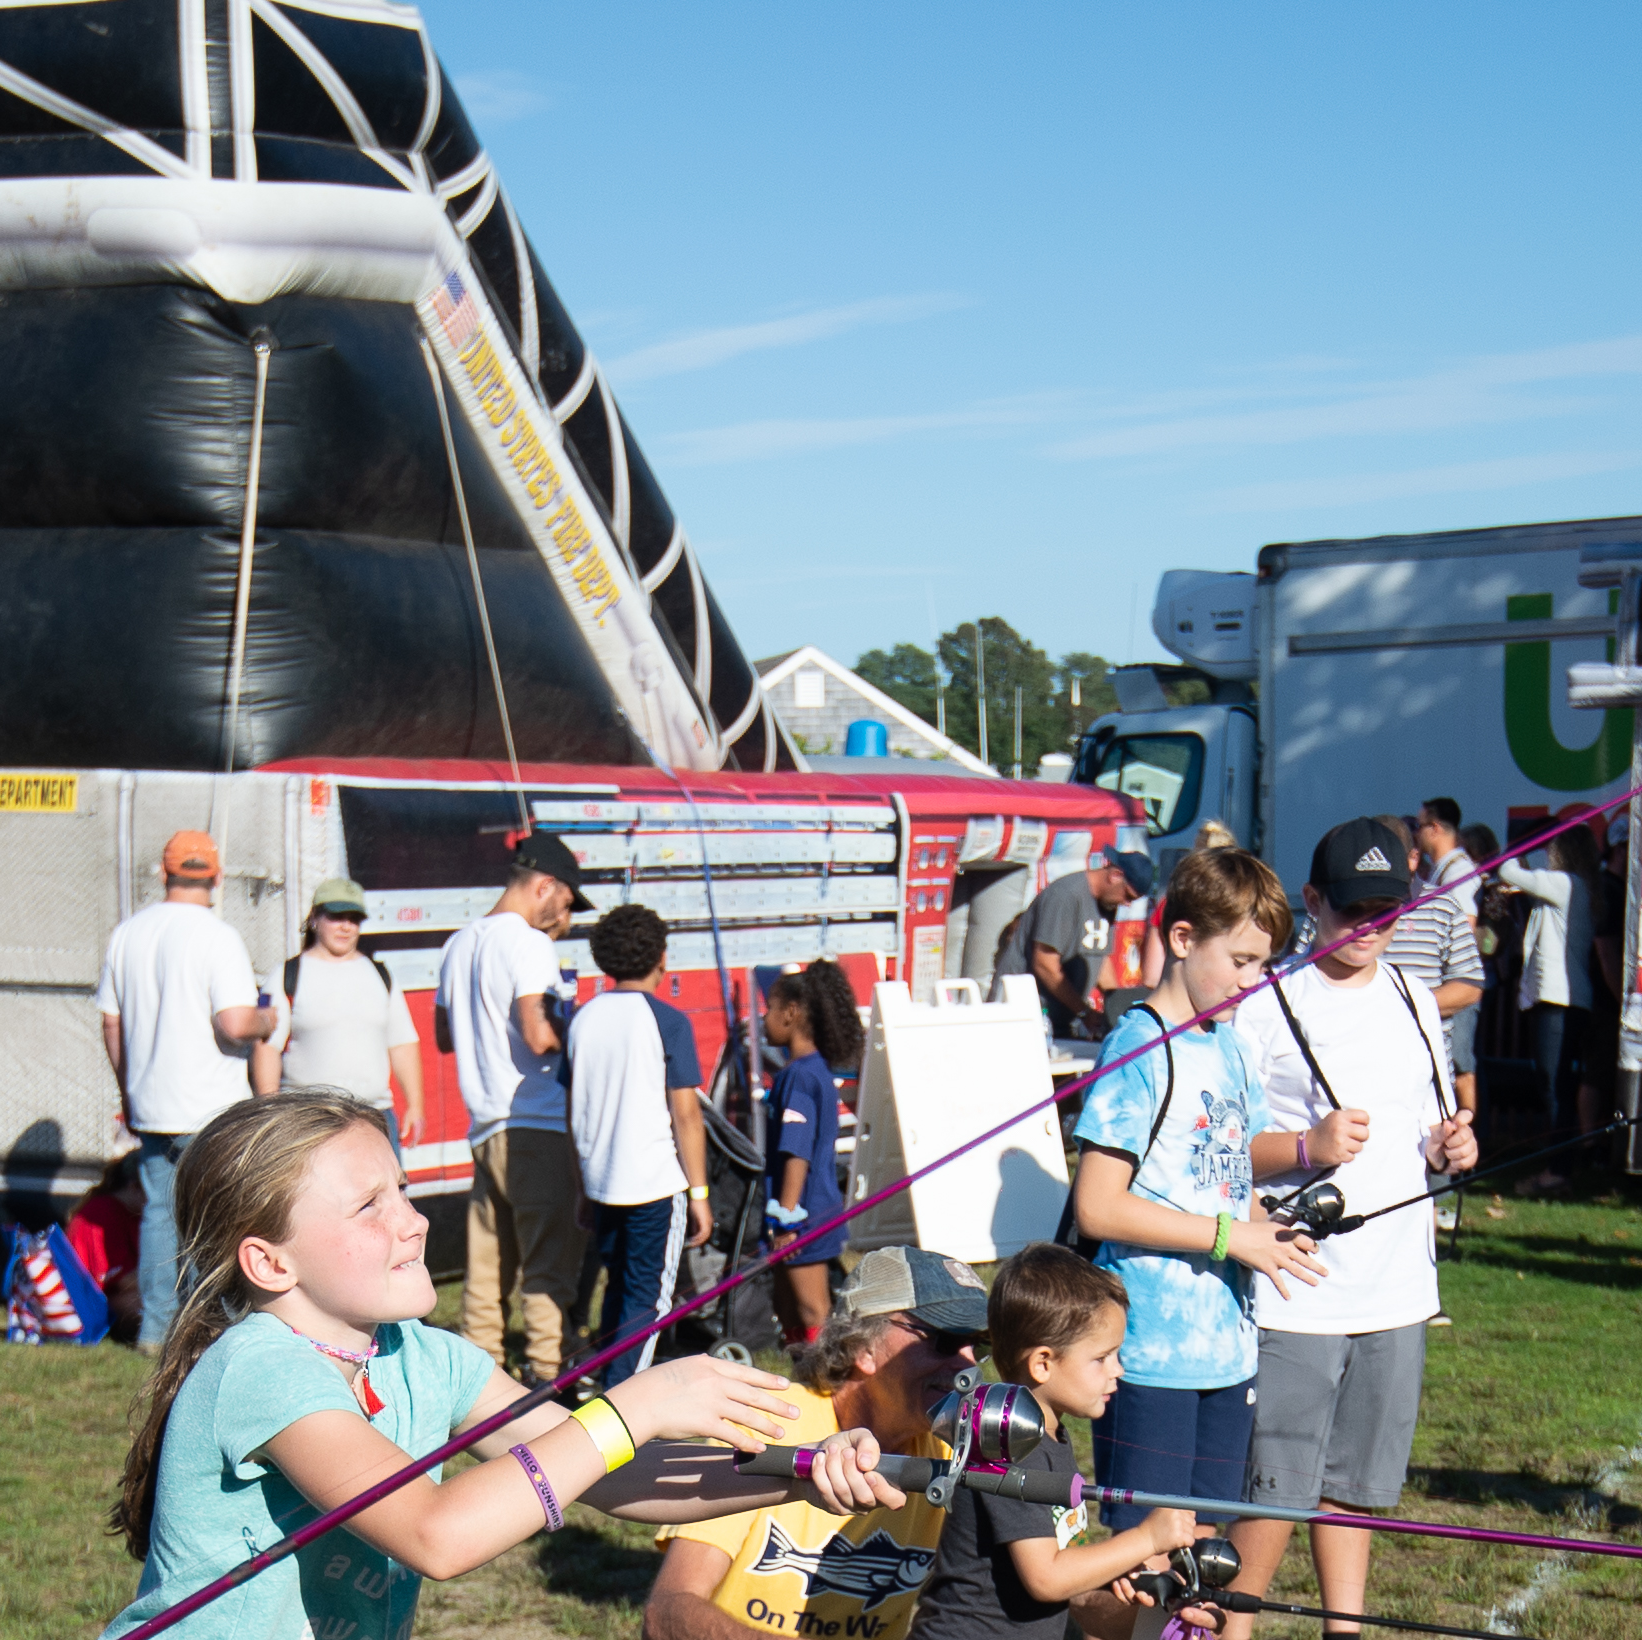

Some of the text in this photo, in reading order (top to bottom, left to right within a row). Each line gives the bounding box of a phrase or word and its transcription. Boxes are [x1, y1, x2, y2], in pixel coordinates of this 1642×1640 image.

[460, 323, 517, 428] UNITED
[501, 409, 562, 510] STATES
[545, 494, 593, 564] FIRE
[746, 1598, 785, 1629] On
[793, 1611, 841, 1637] The
